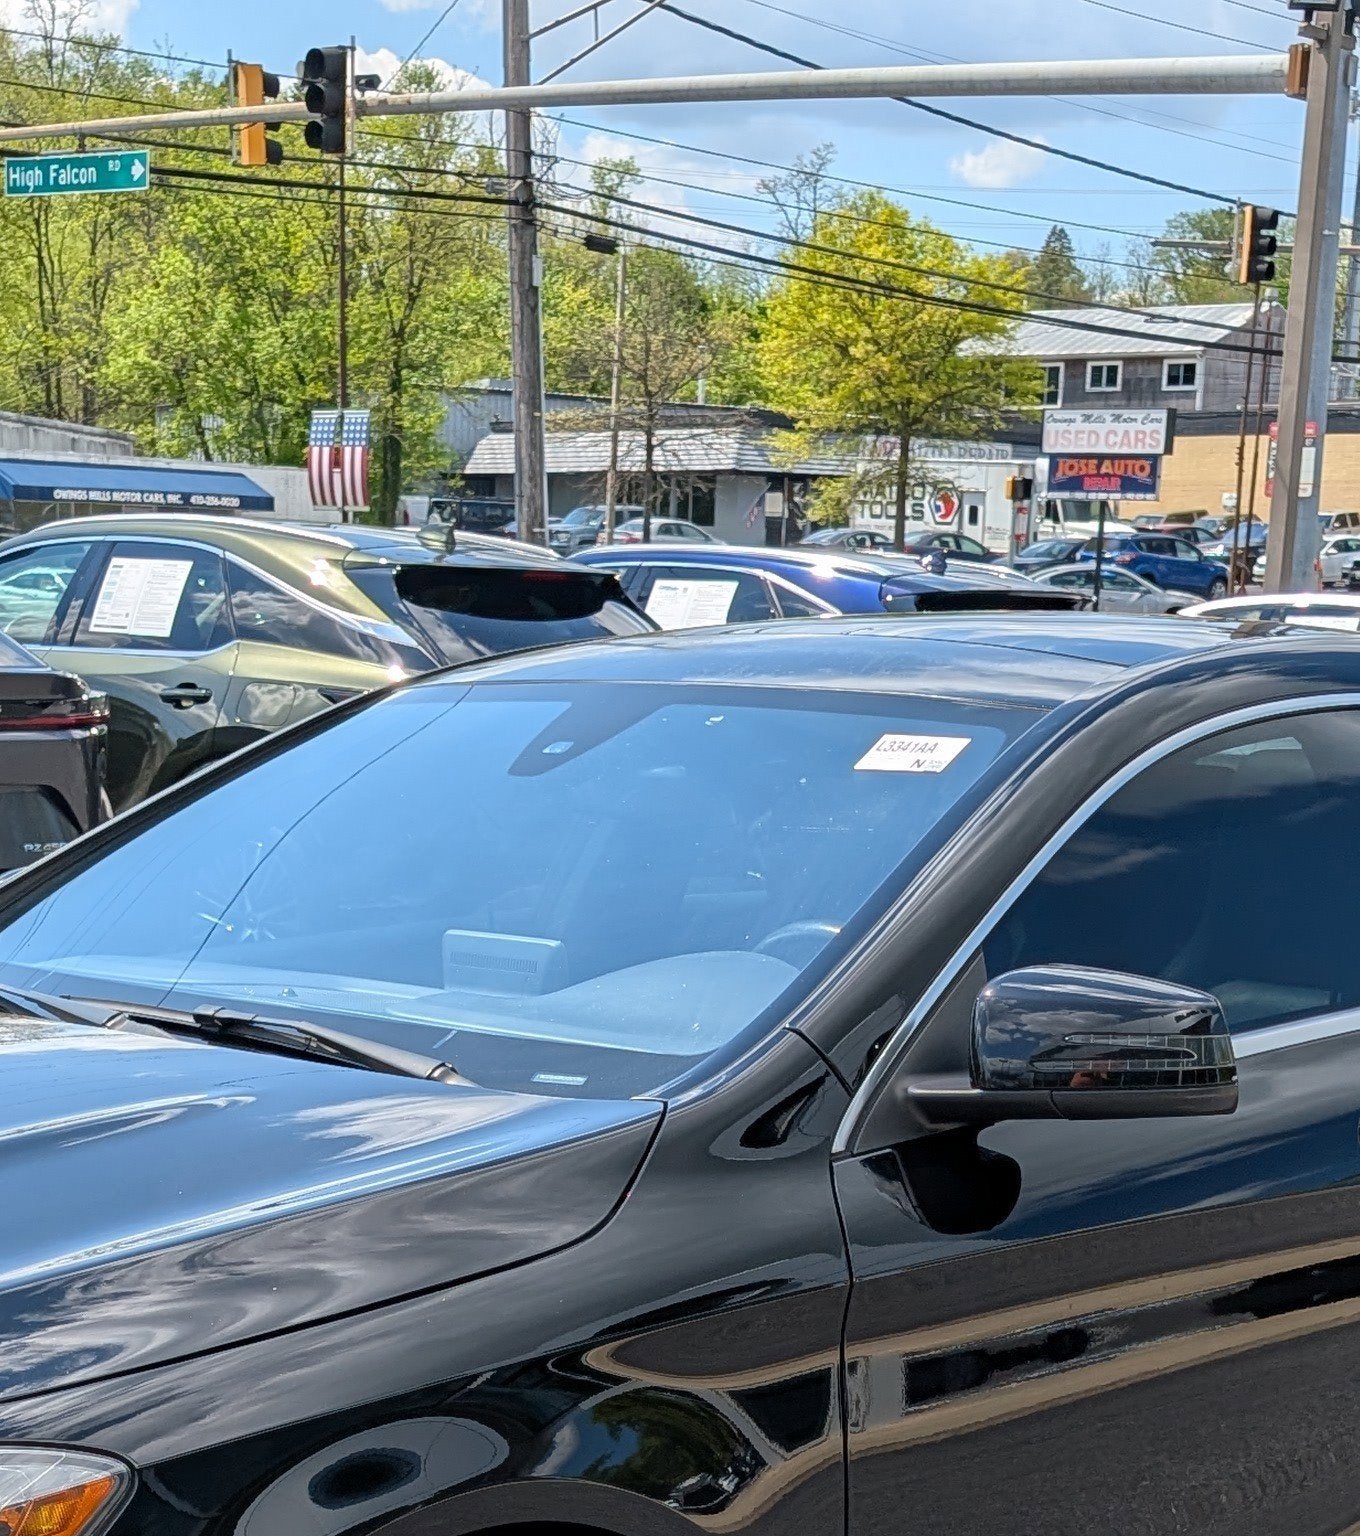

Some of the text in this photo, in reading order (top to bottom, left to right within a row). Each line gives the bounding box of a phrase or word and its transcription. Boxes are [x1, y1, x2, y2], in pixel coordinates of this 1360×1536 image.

[9, 159, 122, 193] High Falcon RD
[1045, 413, 1163, 427] Owings Mills Motor Cars
[1047, 429, 1161, 450] USED CARS
[1055, 458, 1152, 479] JOSE AUTO
[53, 488, 88, 500] OWINGS
[89, 489, 111, 501] MILLS
[112, 490, 141, 502] MOTOR
[910, 758, 927, 769] N
